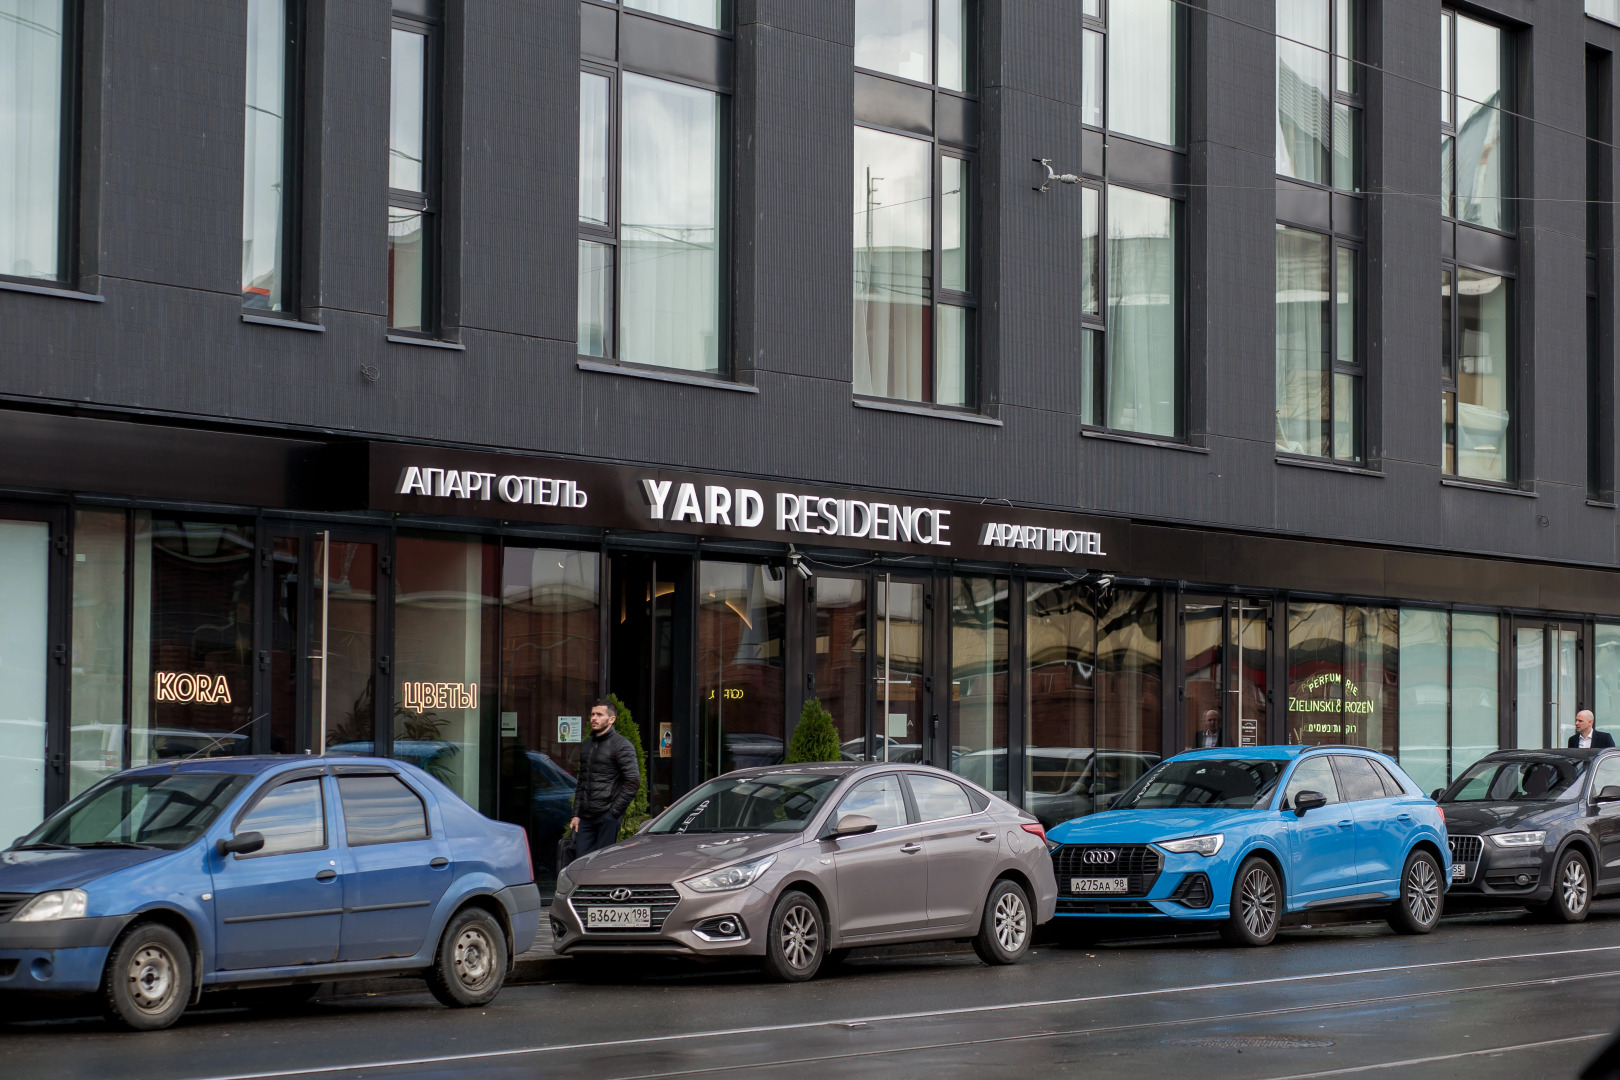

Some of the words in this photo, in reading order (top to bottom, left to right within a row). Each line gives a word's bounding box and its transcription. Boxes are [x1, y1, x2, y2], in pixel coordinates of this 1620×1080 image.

[400, 466, 497, 500] АПАРТ
[498, 474, 588, 508] ОТЕЛЬ
[642, 479, 765, 527] YARD
[776, 492, 951, 546] RESIDENCE
[983, 522, 1047, 550] APART
[1046, 528, 1107, 556] HOTEL
[156, 672, 232, 704] KORA
[404, 682, 478, 713] ЦВЕТЫ
[1308, 673, 1359, 697] PERFUMRIE
[1288, 697, 1334, 713] ZIELINSKI
[1335, 699, 1342, 713] &
[1344, 700, 1374, 714] ROZEN
[1114, 879, 1124, 888] 98
[632, 908, 648, 919] 198
